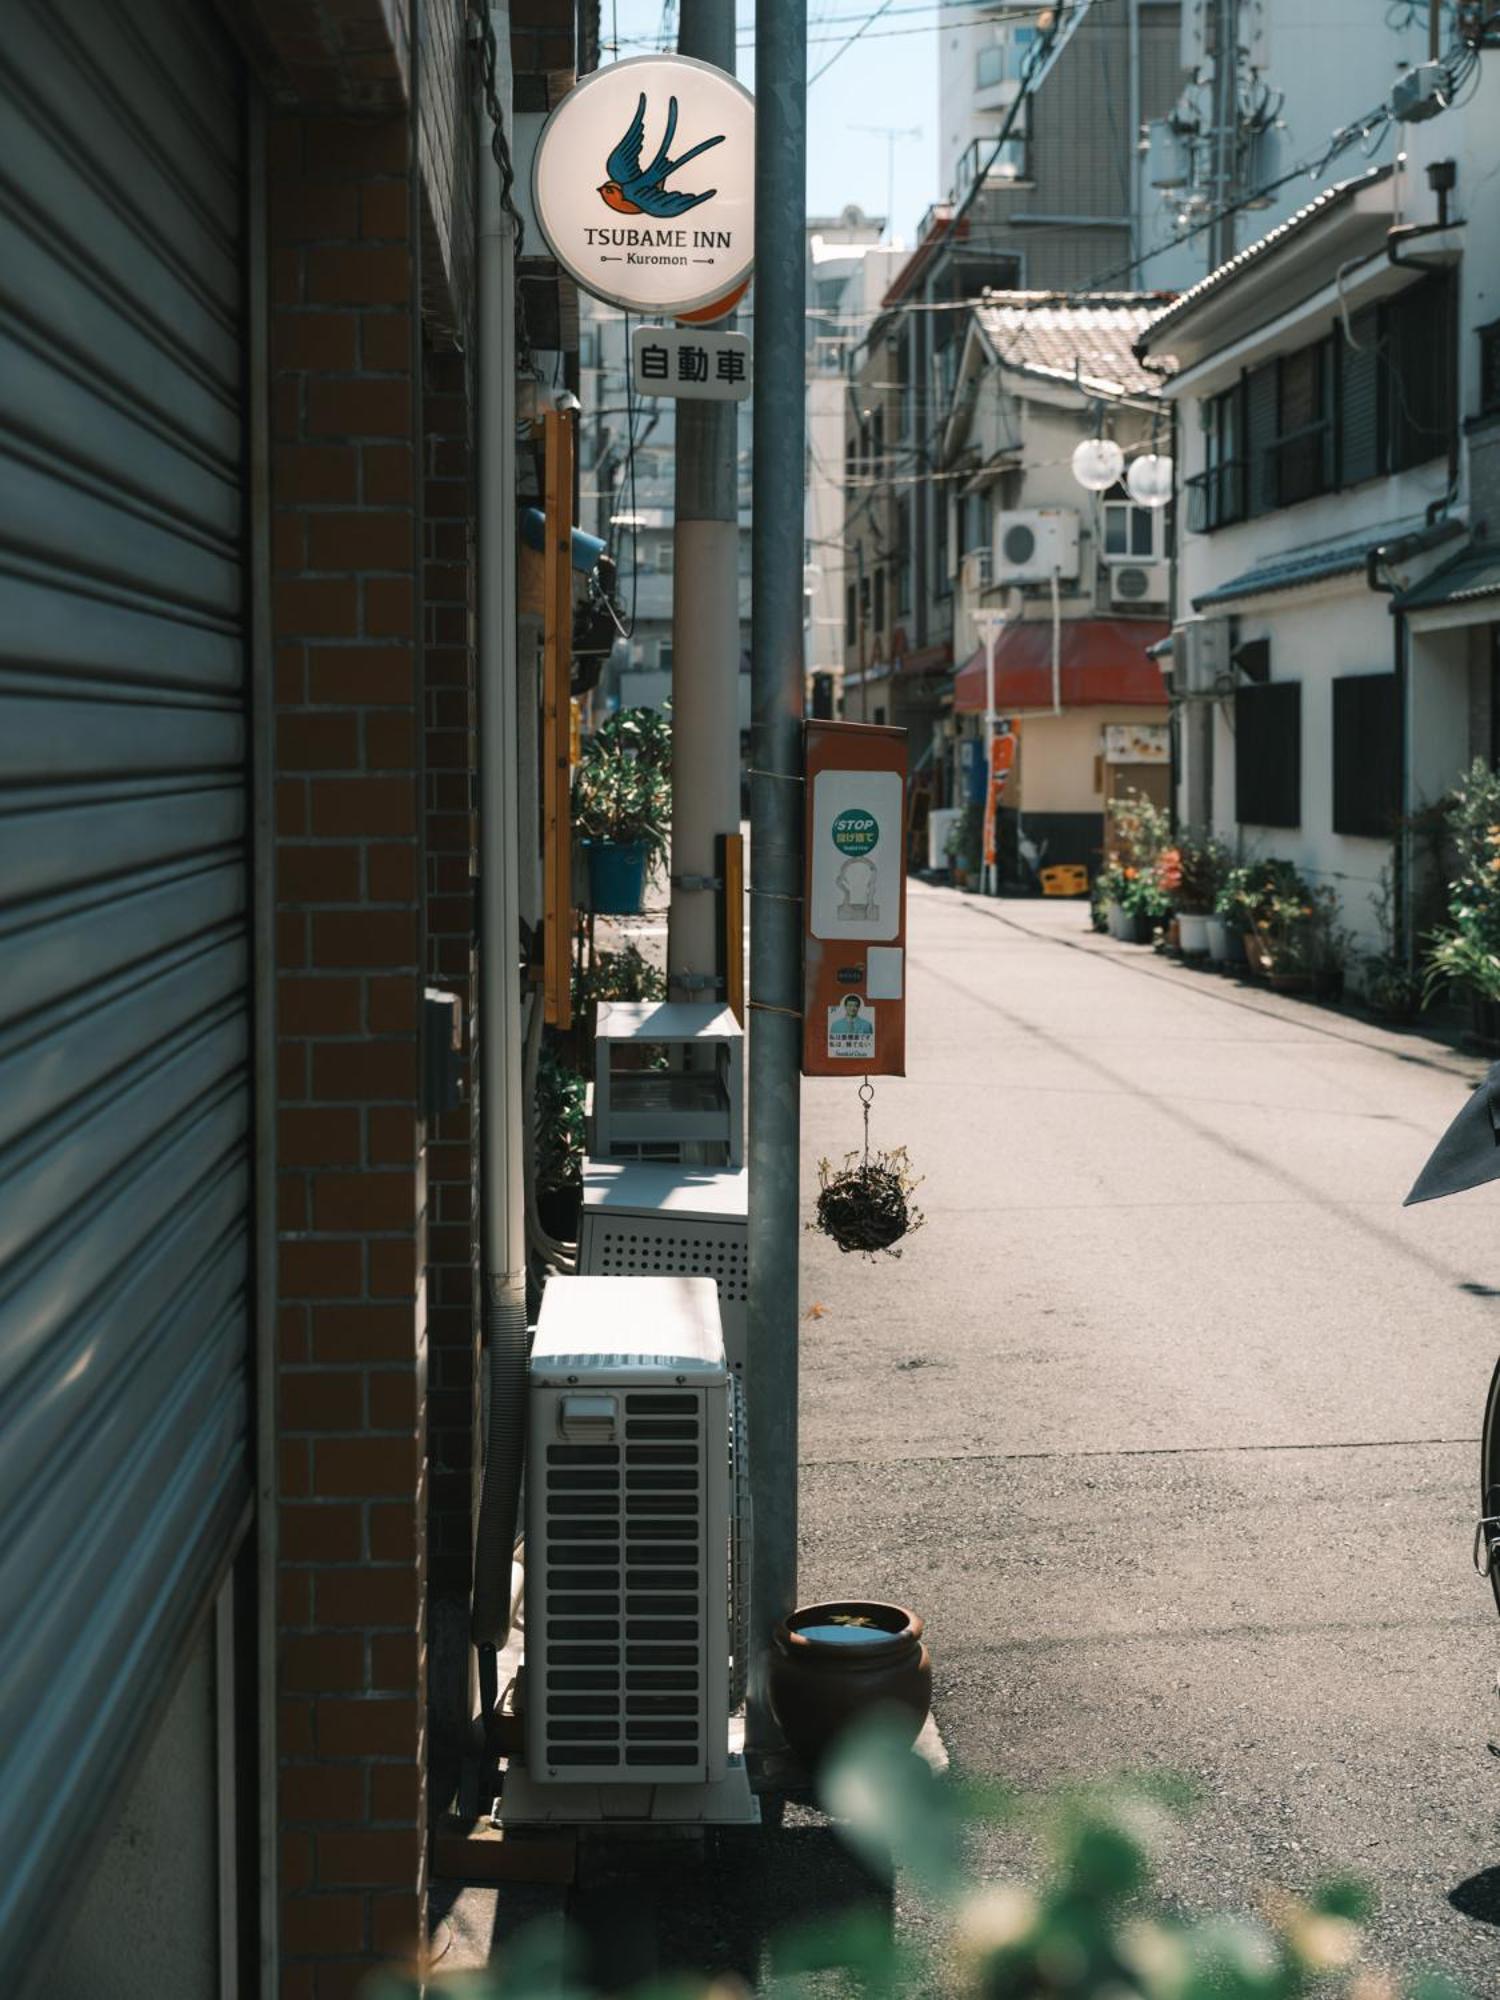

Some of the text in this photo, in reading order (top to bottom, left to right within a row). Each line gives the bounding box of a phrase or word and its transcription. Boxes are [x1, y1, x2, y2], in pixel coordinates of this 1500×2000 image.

[583, 228, 732, 248] TSUBAME INN
[626, 252, 688, 265] Kuromon
[641, 344, 746, 385] 自動車
[837, 819, 874, 831] STOP
